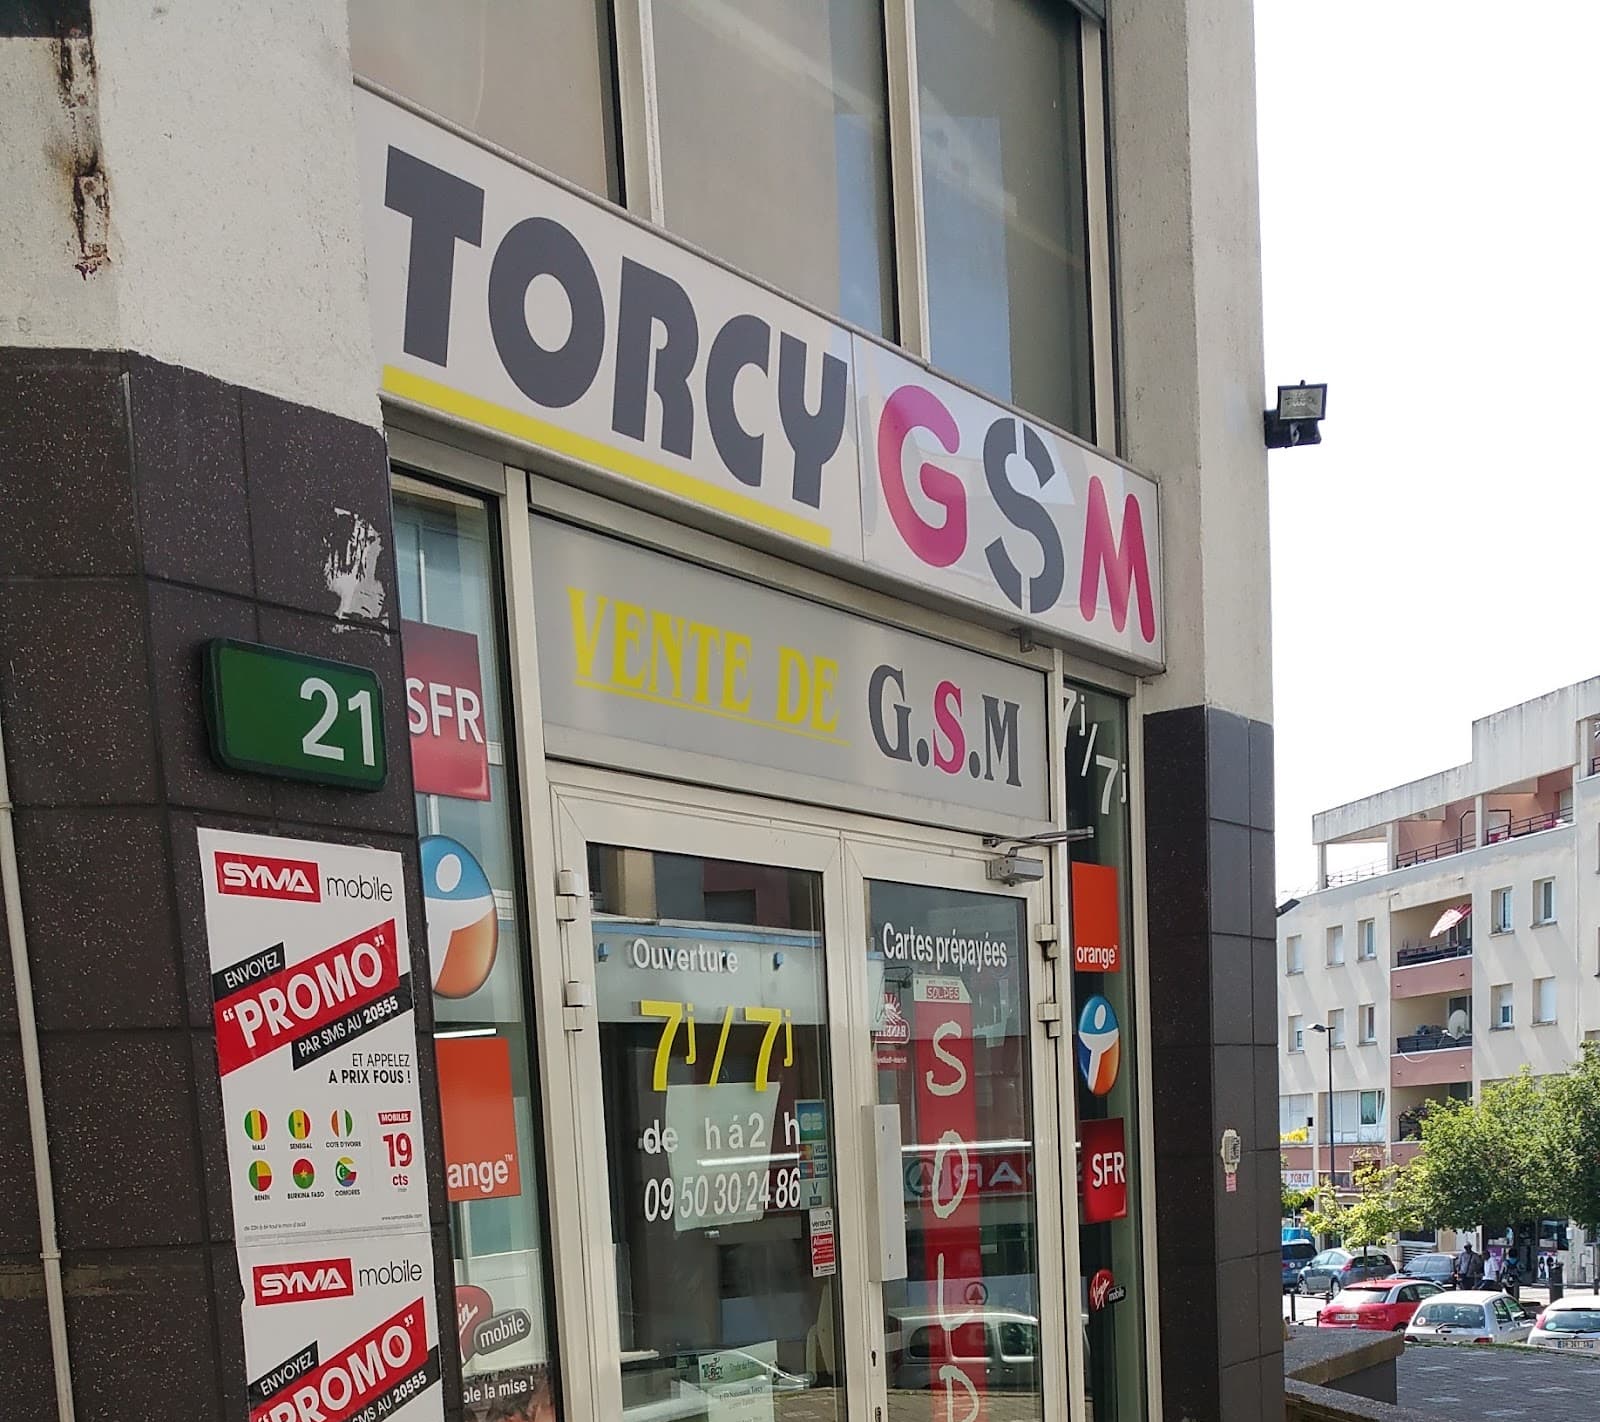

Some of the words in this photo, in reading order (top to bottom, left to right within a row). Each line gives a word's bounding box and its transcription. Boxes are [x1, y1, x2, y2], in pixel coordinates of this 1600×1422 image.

[384, 144, 849, 509] TORCY
[878, 385, 1155, 643] GSM
[566, 585, 752, 714] VENTE
[776, 645, 840, 734] DE
[868, 664, 1022, 787] G.S.M
[301, 677, 376, 766] 21
[406, 677, 484, 744] SFR
[222, 862, 314, 893] SYMA
[326, 875, 393, 901] mobile
[632, 938, 738, 973] Ouverture
[883, 922, 933, 962] Cartes
[936, 928, 1008, 973] prépayées
[1077, 946, 1116, 969] orange
[224, 952, 280, 989] ENVOYEZ
[927, 987, 959, 999] SOLDES
[298, 1035, 322, 1057] PAR
[322, 1024, 346, 1045] SMS
[347, 1014, 362, 1034] AU
[363, 995, 399, 1024] 20555
[328, 1070, 338, 1084] A
[341, 1070, 370, 1084] PRIX
[352, 1053, 364, 1067] ET
[366, 1053, 411, 1068] APPELEZ
[380, 1113, 409, 1122] MOBILES
[643, 1120, 679, 1154] de
[783, 1112, 801, 1146] h
[383, 1133, 412, 1168] 19
[392, 1174, 409, 1186] cts
[448, 1160, 508, 1193] ange
[1092, 1151, 1126, 1188] SFR
[287, 1192, 310, 1200] BURKINA
[311, 1191, 325, 1199] FASO
[261, 1268, 347, 1296] SYMA
[359, 1259, 422, 1287] mobile
[1109, 1287, 1124, 1302] mobile
[480, 1315, 525, 1348] mobile
[260, 1351, 314, 1396] ENVOYEZ
[485, 1383, 495, 1400] la
[499, 1378, 527, 1396] mise
[377, 1396, 392, 1416] AU
[393, 1371, 427, 1403] 20555
